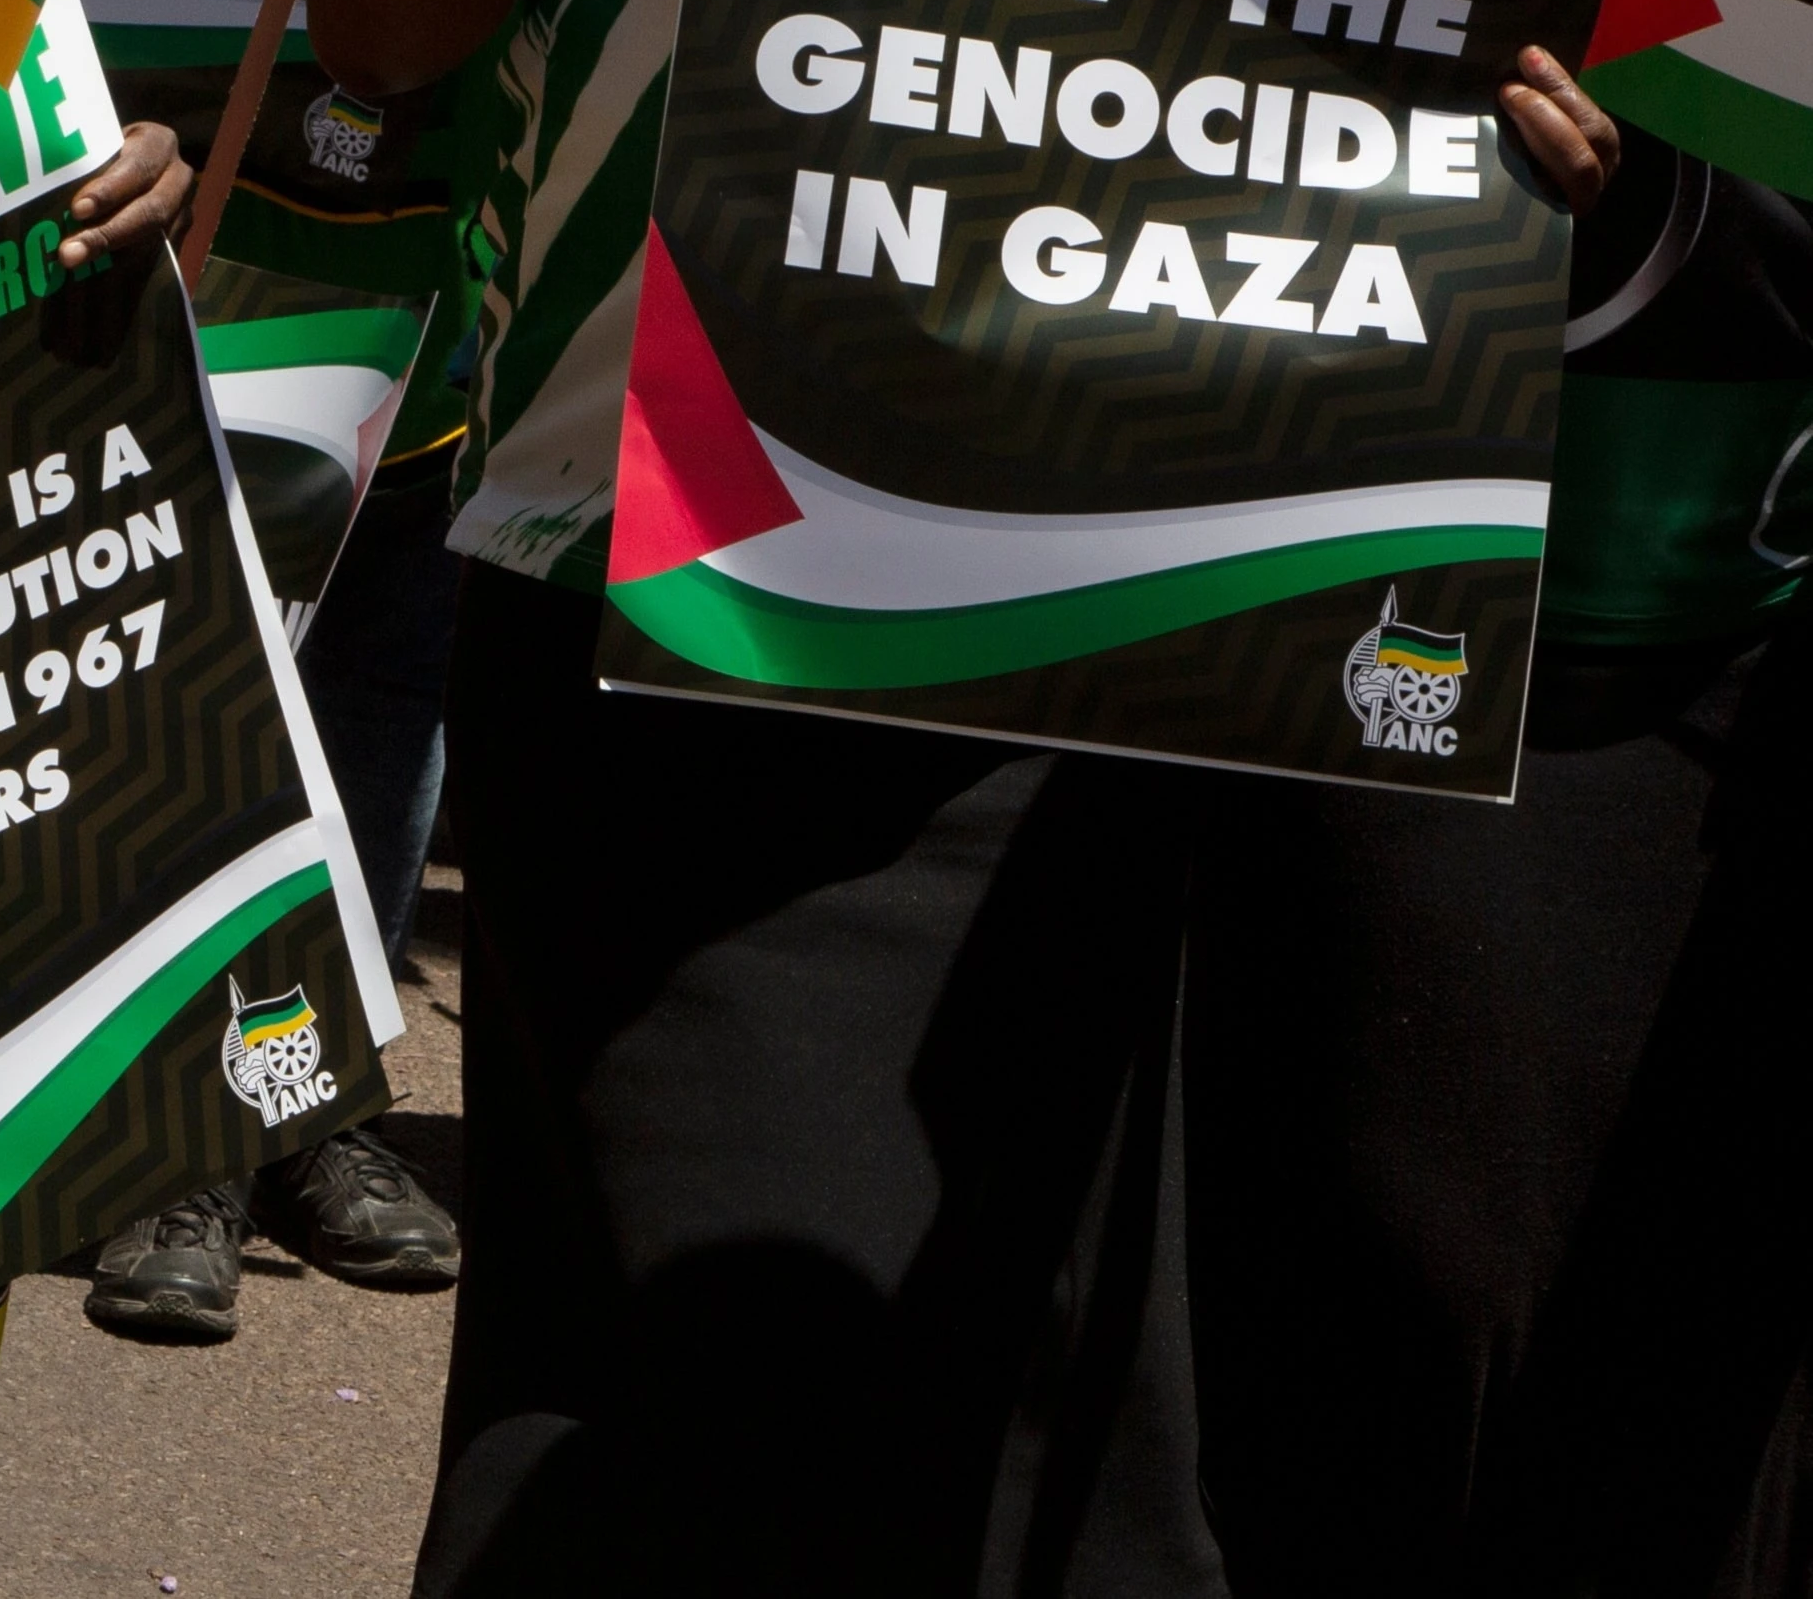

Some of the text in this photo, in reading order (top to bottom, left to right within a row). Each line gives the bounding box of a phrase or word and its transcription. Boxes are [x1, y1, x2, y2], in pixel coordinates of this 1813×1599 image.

[755, 13, 1481, 199] GENOCIDE
[321, 151, 370, 183] ANC
[784, 169, 1428, 344] IN GAZA
[8, 453, 77, 529] IS
[101, 424, 152, 491] A
[1382, 720, 1459, 757] ANC
[279, 1070, 338, 1121] ANC
